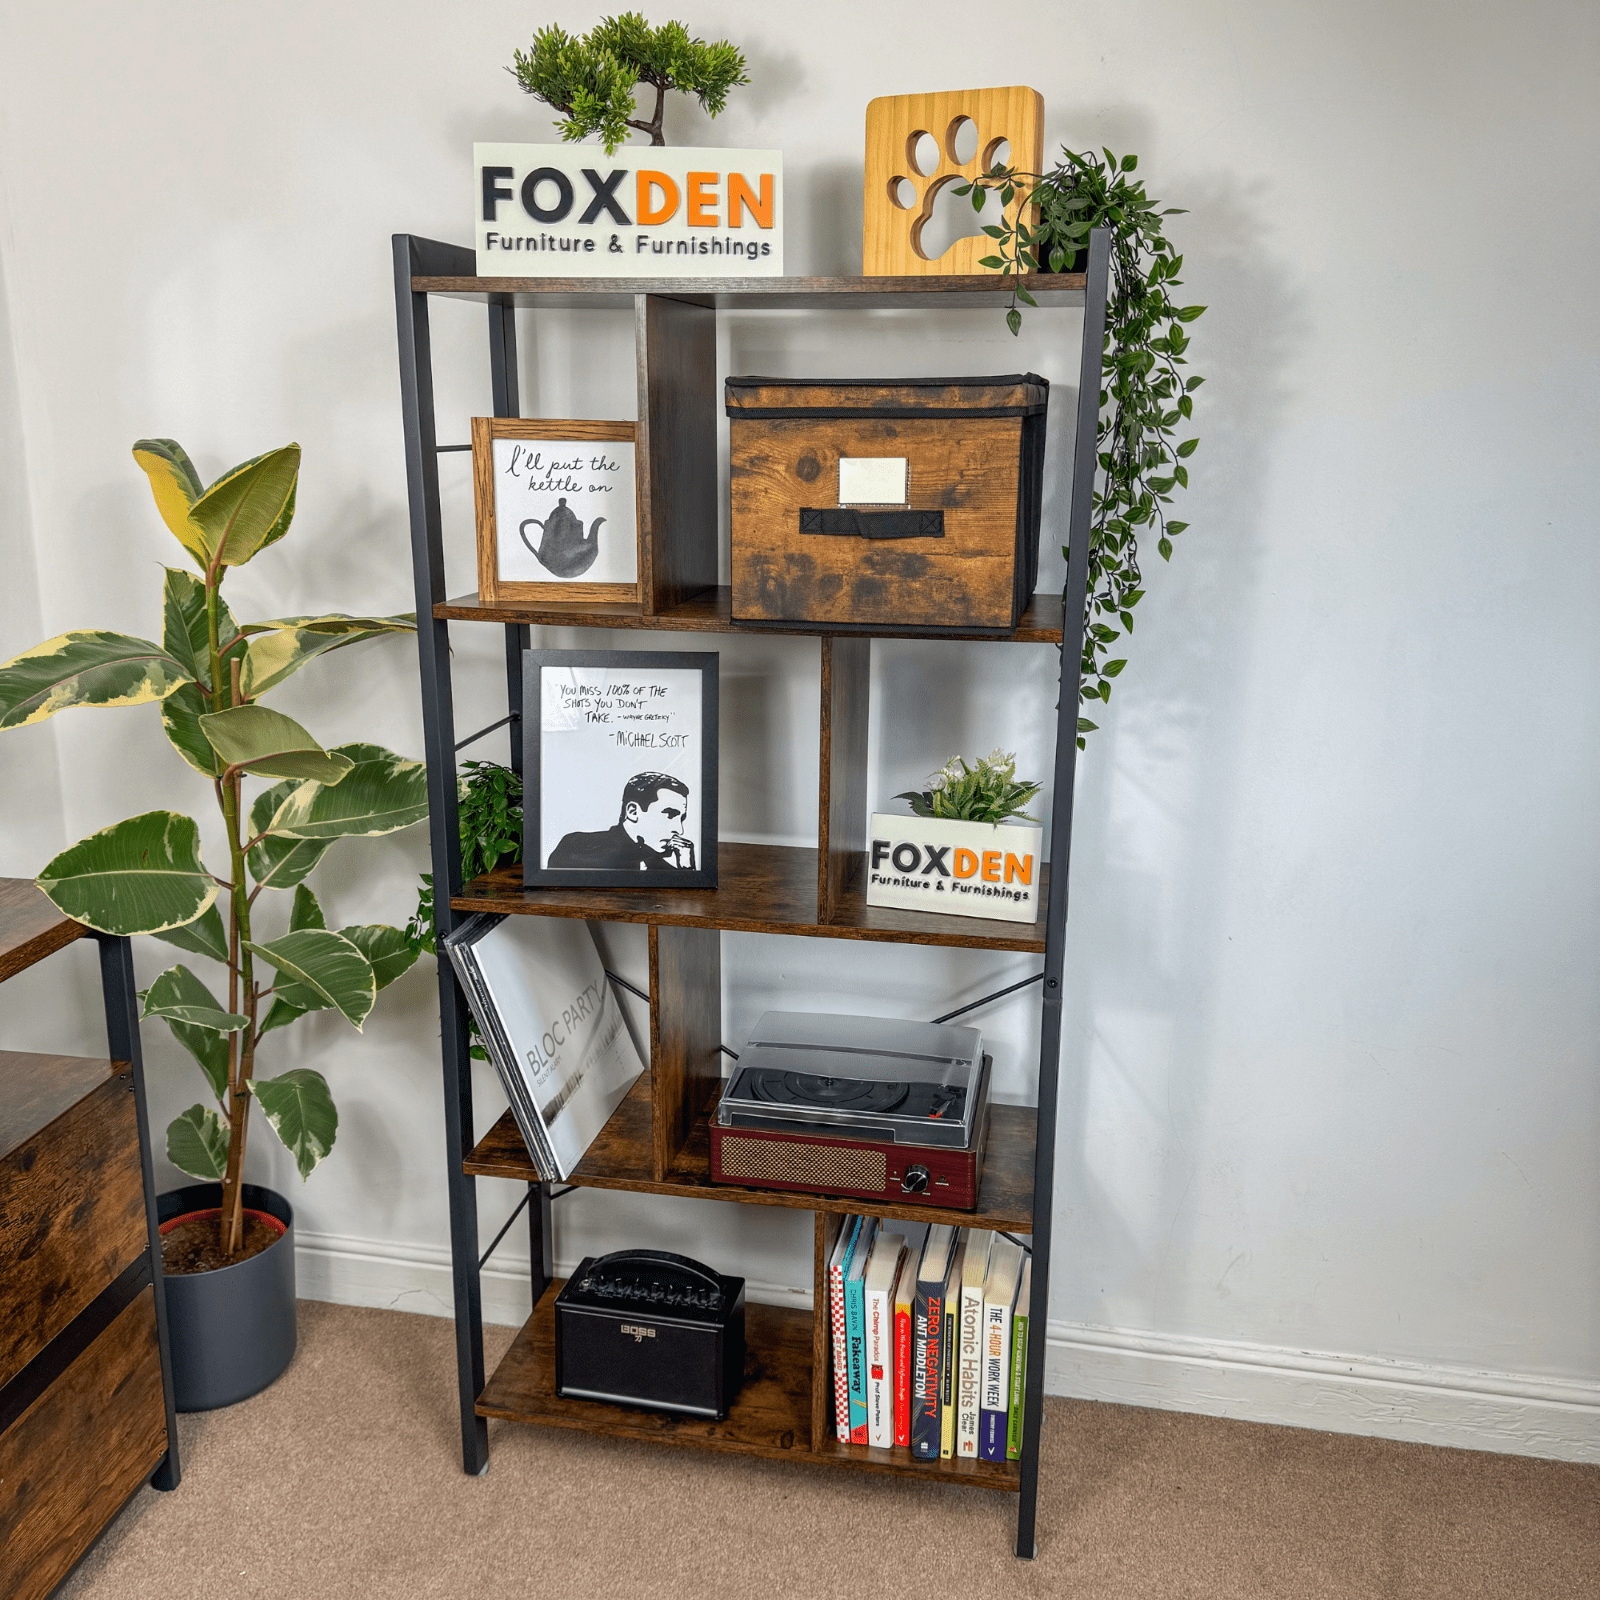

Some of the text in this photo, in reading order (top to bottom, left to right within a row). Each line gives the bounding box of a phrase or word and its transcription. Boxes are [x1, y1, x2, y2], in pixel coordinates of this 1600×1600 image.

[481, 166, 774, 229] FOXDEN
[486, 231, 771, 260] Furniture & Furnishings
[505, 444, 620, 479] I'll put the
[528, 475, 613, 492] kettle on
[563, 698, 648, 712] SHOTS YOU DON'T
[606, 684, 630, 697] 100%
[632, 686, 646, 696] OF
[649, 685, 668, 698] THE
[584, 710, 614, 723] TAKE.
[658, 732, 690, 748] SCOTT
[871, 839, 1033, 885] FOXDEN
[871, 873, 1029, 901] Furniture & Furnishings
[526, 979, 602, 1076] BLOC PARTY
[620, 1324, 656, 1338] BOSS
[872, 1311, 880, 1335] Chimp
[851, 1336, 862, 1394] Fakeaway
[915, 1314, 928, 1399] ANT MIDDLETON
[925, 1296, 940, 1418] ZERO NEGATIVITY
[961, 1295, 980, 1408] Atomic Habits
[987, 1308, 1003, 1407] THE 4-HOUR WORK WEEK
[961, 1413, 969, 1432] Clear
[968, 1411, 976, 1435] James
